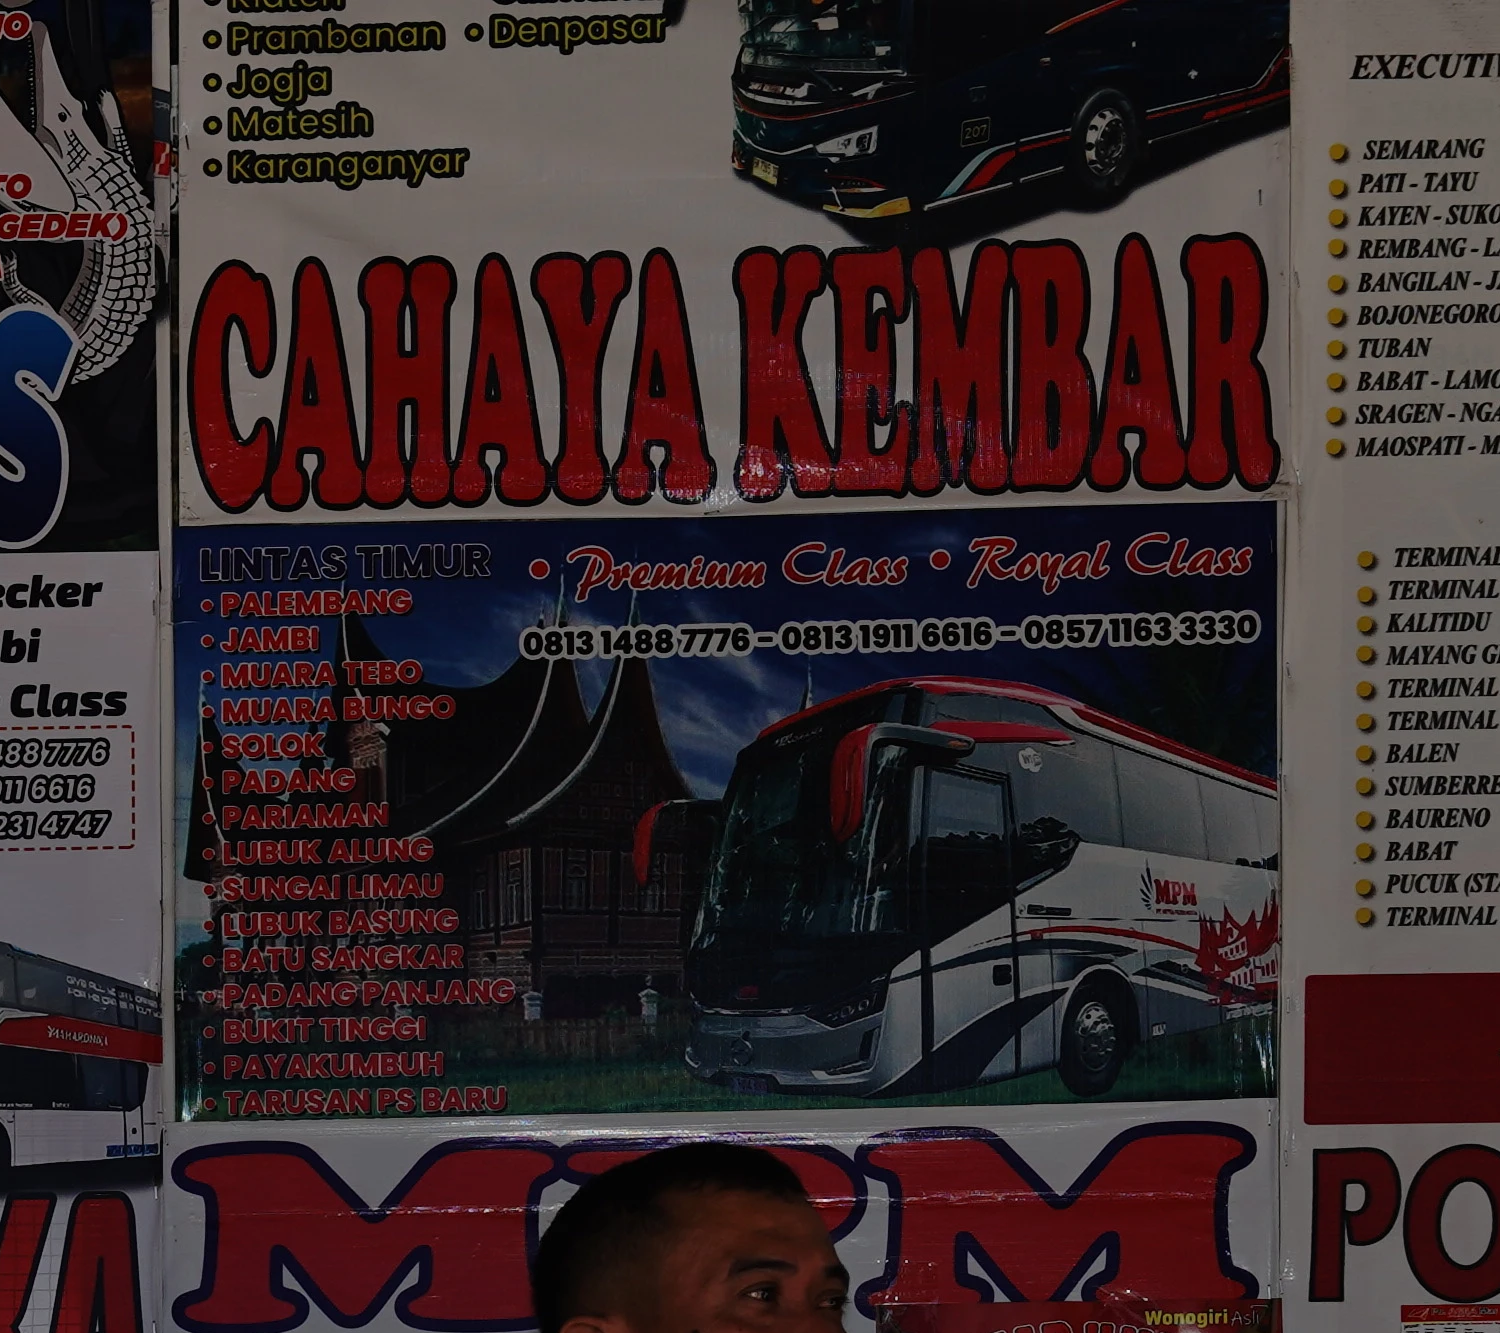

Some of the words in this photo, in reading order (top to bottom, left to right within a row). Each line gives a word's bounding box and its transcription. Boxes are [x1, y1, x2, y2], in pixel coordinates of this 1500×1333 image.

[229, 18, 446, 56] Prambanan
[492, 11, 668, 52] Denpasar
[963, 122, 988, 142] 207
[1363, 138, 1485, 160] SEMARANG
[229, 146, 470, 186] Karanganyar
[189, 247, 716, 509] CAHAYA
[733, 232, 1280, 500] KEMBAR
[199, 544, 349, 580] LINTAS
[358, 543, 491, 578] TIMUR
[568, 544, 767, 600] Premium
[782, 539, 909, 588] Class
[969, 535, 1113, 591] Royal
[1125, 531, 1252, 579] Class
[221, 588, 413, 616] PALEMBANG
[1388, 579, 1499, 600] TERMINAL
[10, 684, 127, 718] Class
[40, 738, 109, 767] 7776
[221, 733, 325, 761] SOLOK
[172, 1121, 1257, 1333] MM
[1145, 1310, 1228, 1327] Wonogiri
[1230, 1310, 1262, 1326] Asli
